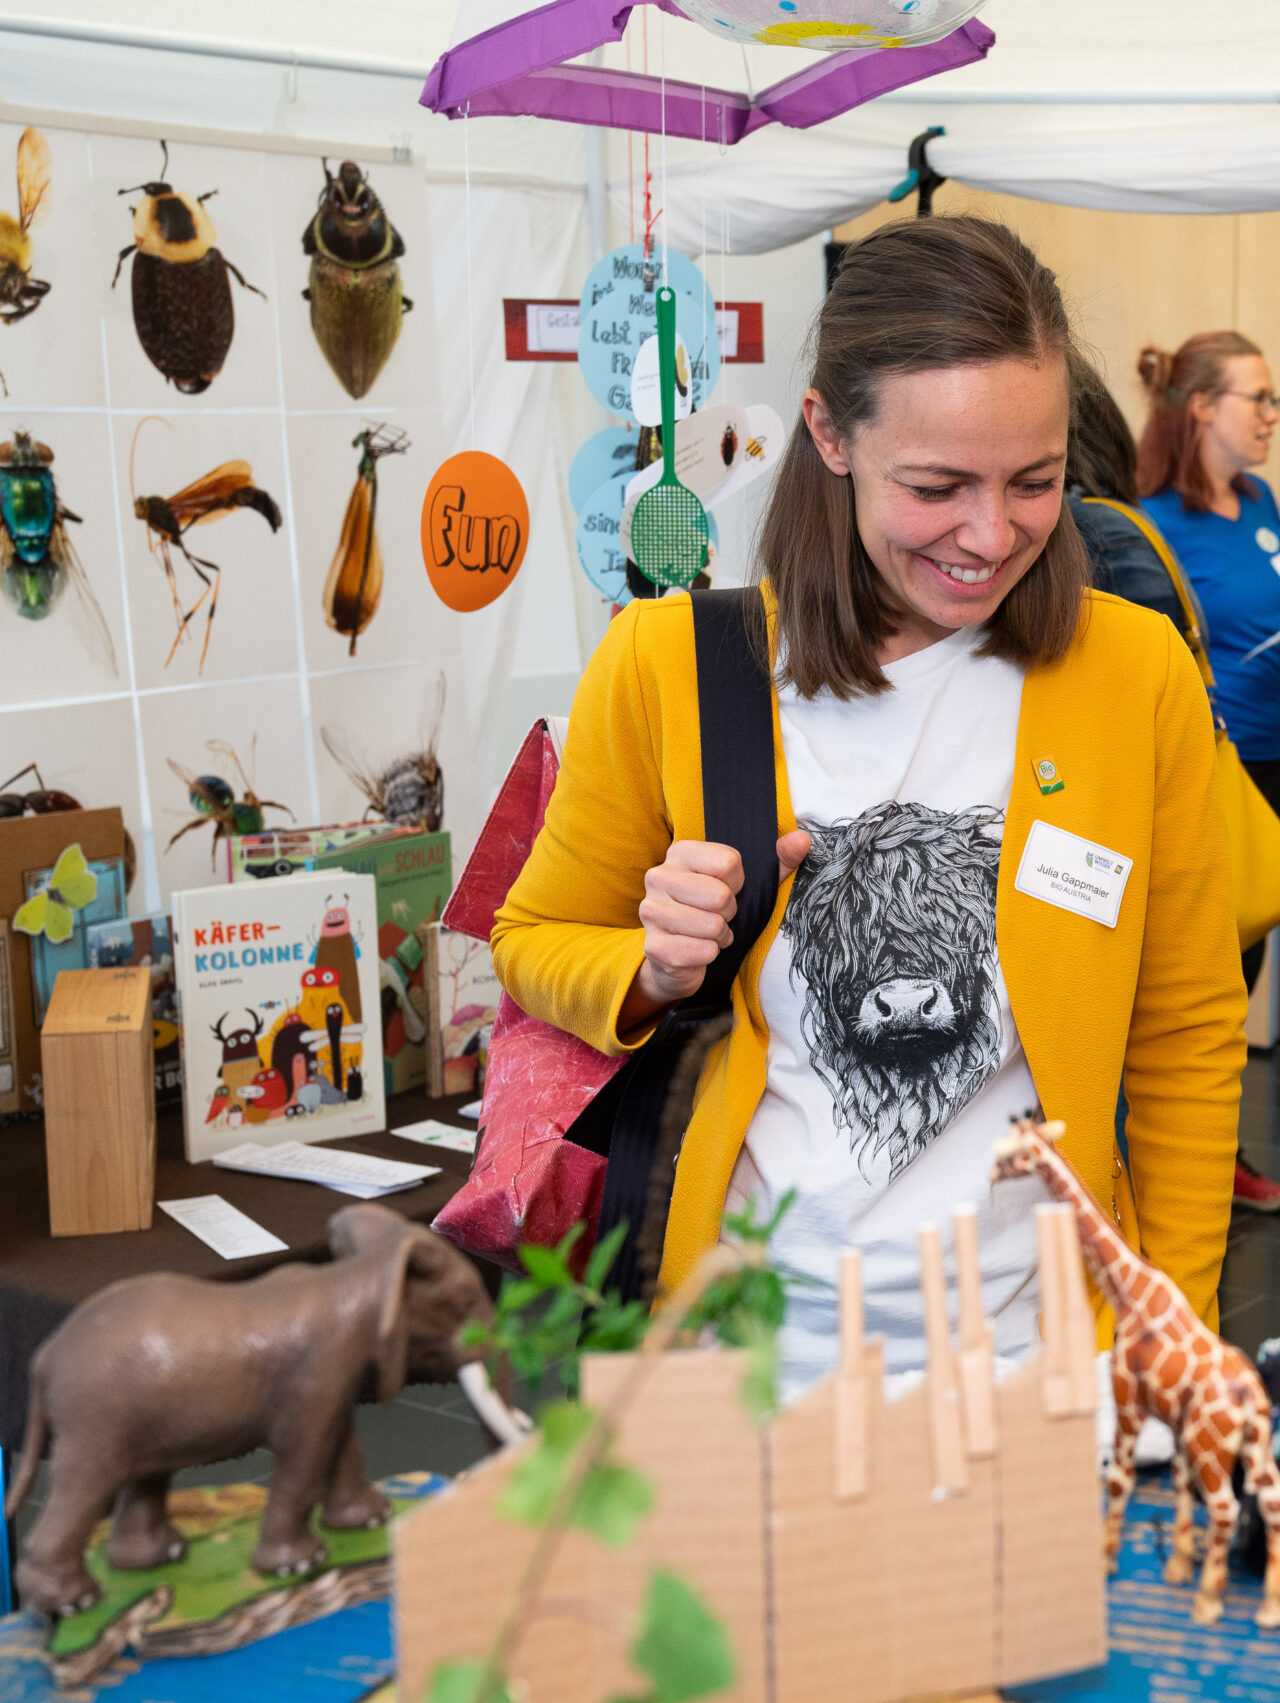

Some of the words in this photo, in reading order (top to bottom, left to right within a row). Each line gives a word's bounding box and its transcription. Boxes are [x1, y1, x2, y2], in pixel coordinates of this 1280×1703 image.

[430, 485, 521, 575] Fun
[1037, 863, 1059, 879] Julia
[1061, 872, 1110, 899] Gappmaier
[194, 942, 304, 973] KOLONNE
